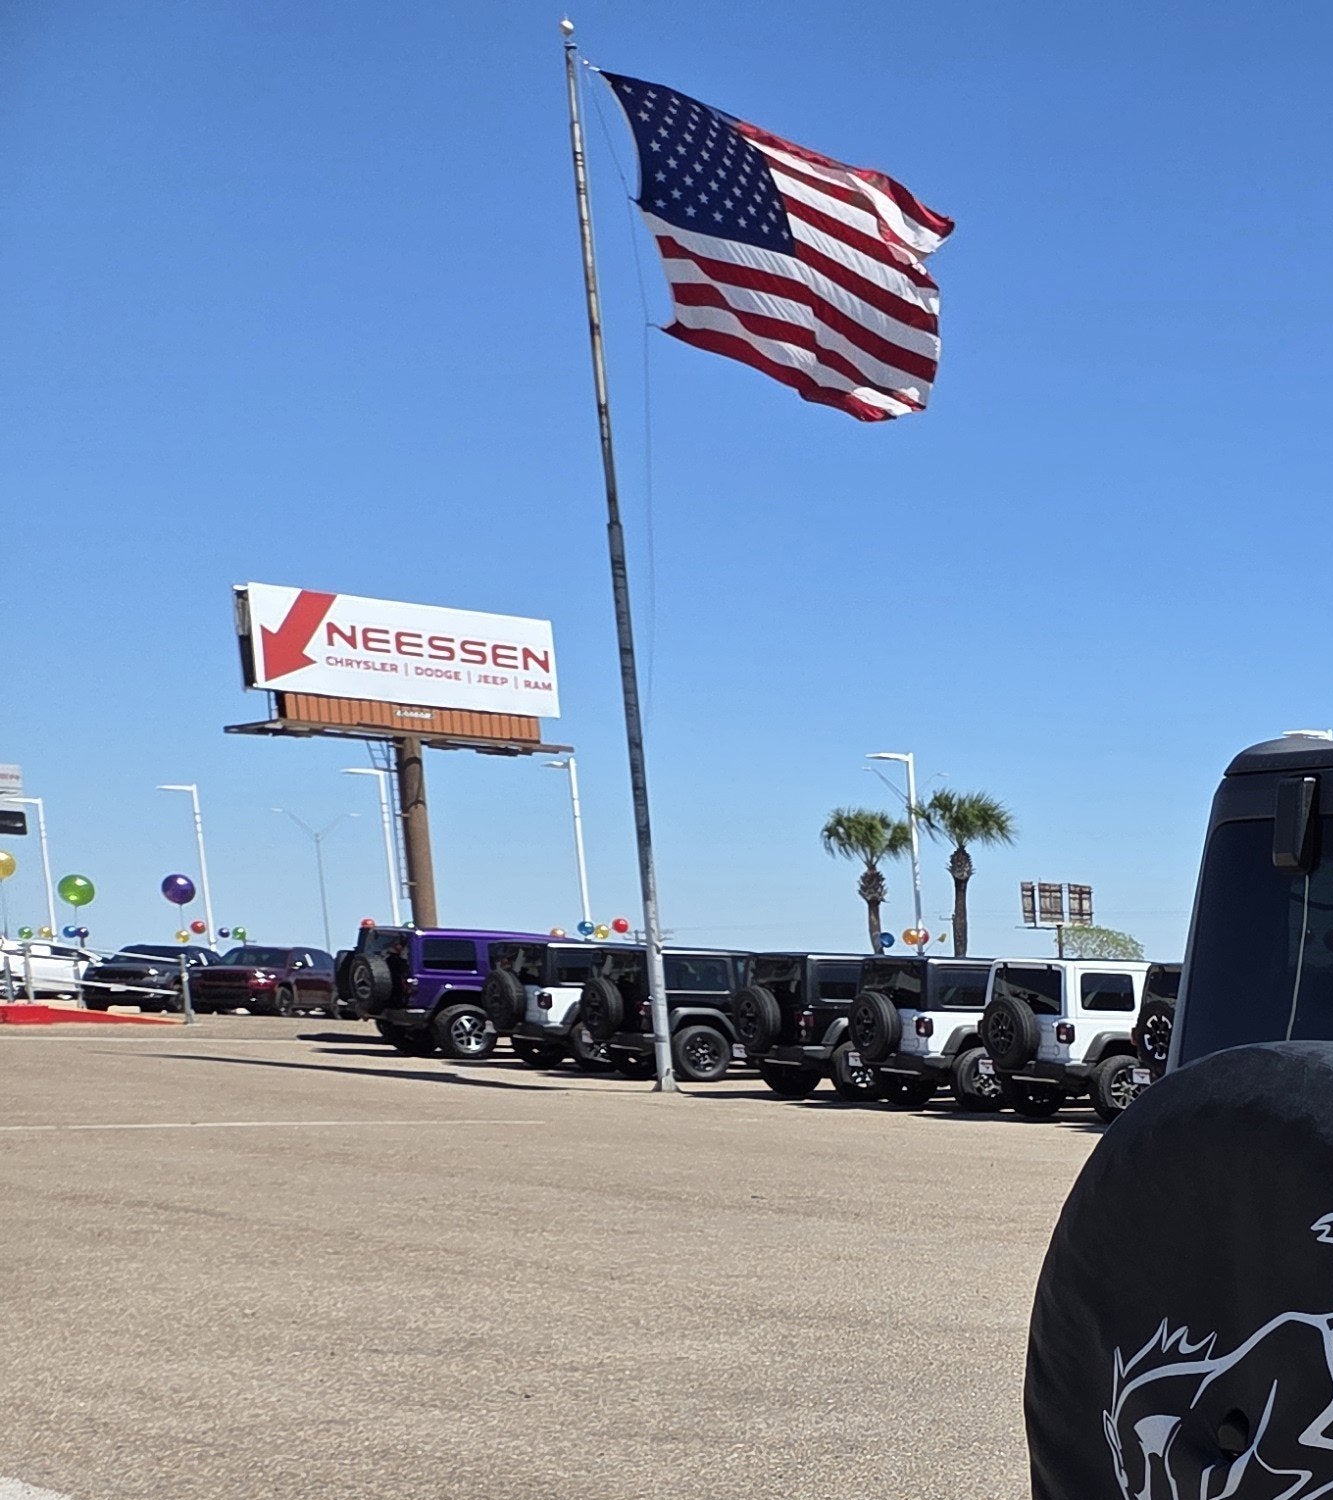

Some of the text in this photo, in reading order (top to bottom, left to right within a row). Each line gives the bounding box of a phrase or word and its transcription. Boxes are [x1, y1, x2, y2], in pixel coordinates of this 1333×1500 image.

[325, 621, 551, 674] NEESSEN
[325, 655, 553, 692] CHRYSLER DODGE JEEP RAM
